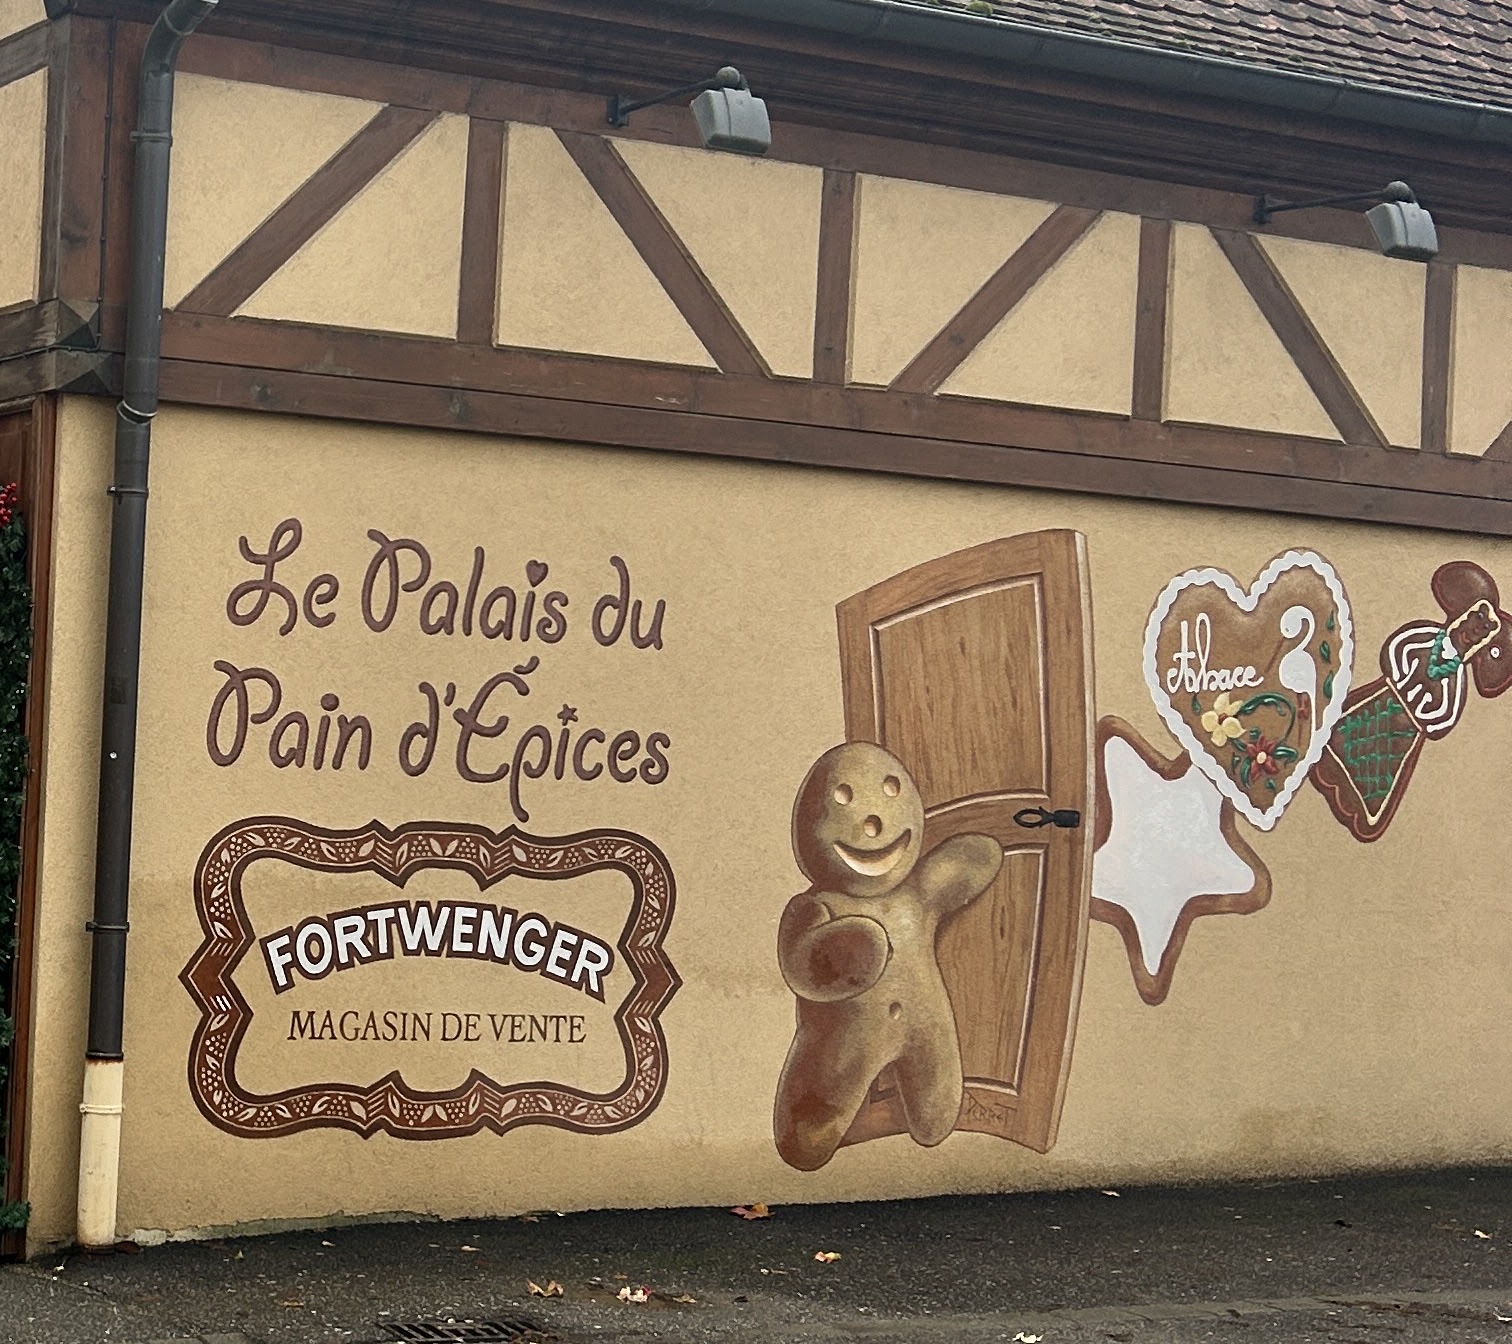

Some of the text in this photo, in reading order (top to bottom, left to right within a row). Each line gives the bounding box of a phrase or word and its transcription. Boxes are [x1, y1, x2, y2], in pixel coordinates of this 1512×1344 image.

[226, 517, 667, 650] Le Palais du
[1166, 612, 1265, 694] Alsace
[206, 655, 671, 823] Pain d'Épices
[262, 903, 612, 998] FORTWENGER
[287, 1010, 587, 1044] MAGASIN DE VENTE
